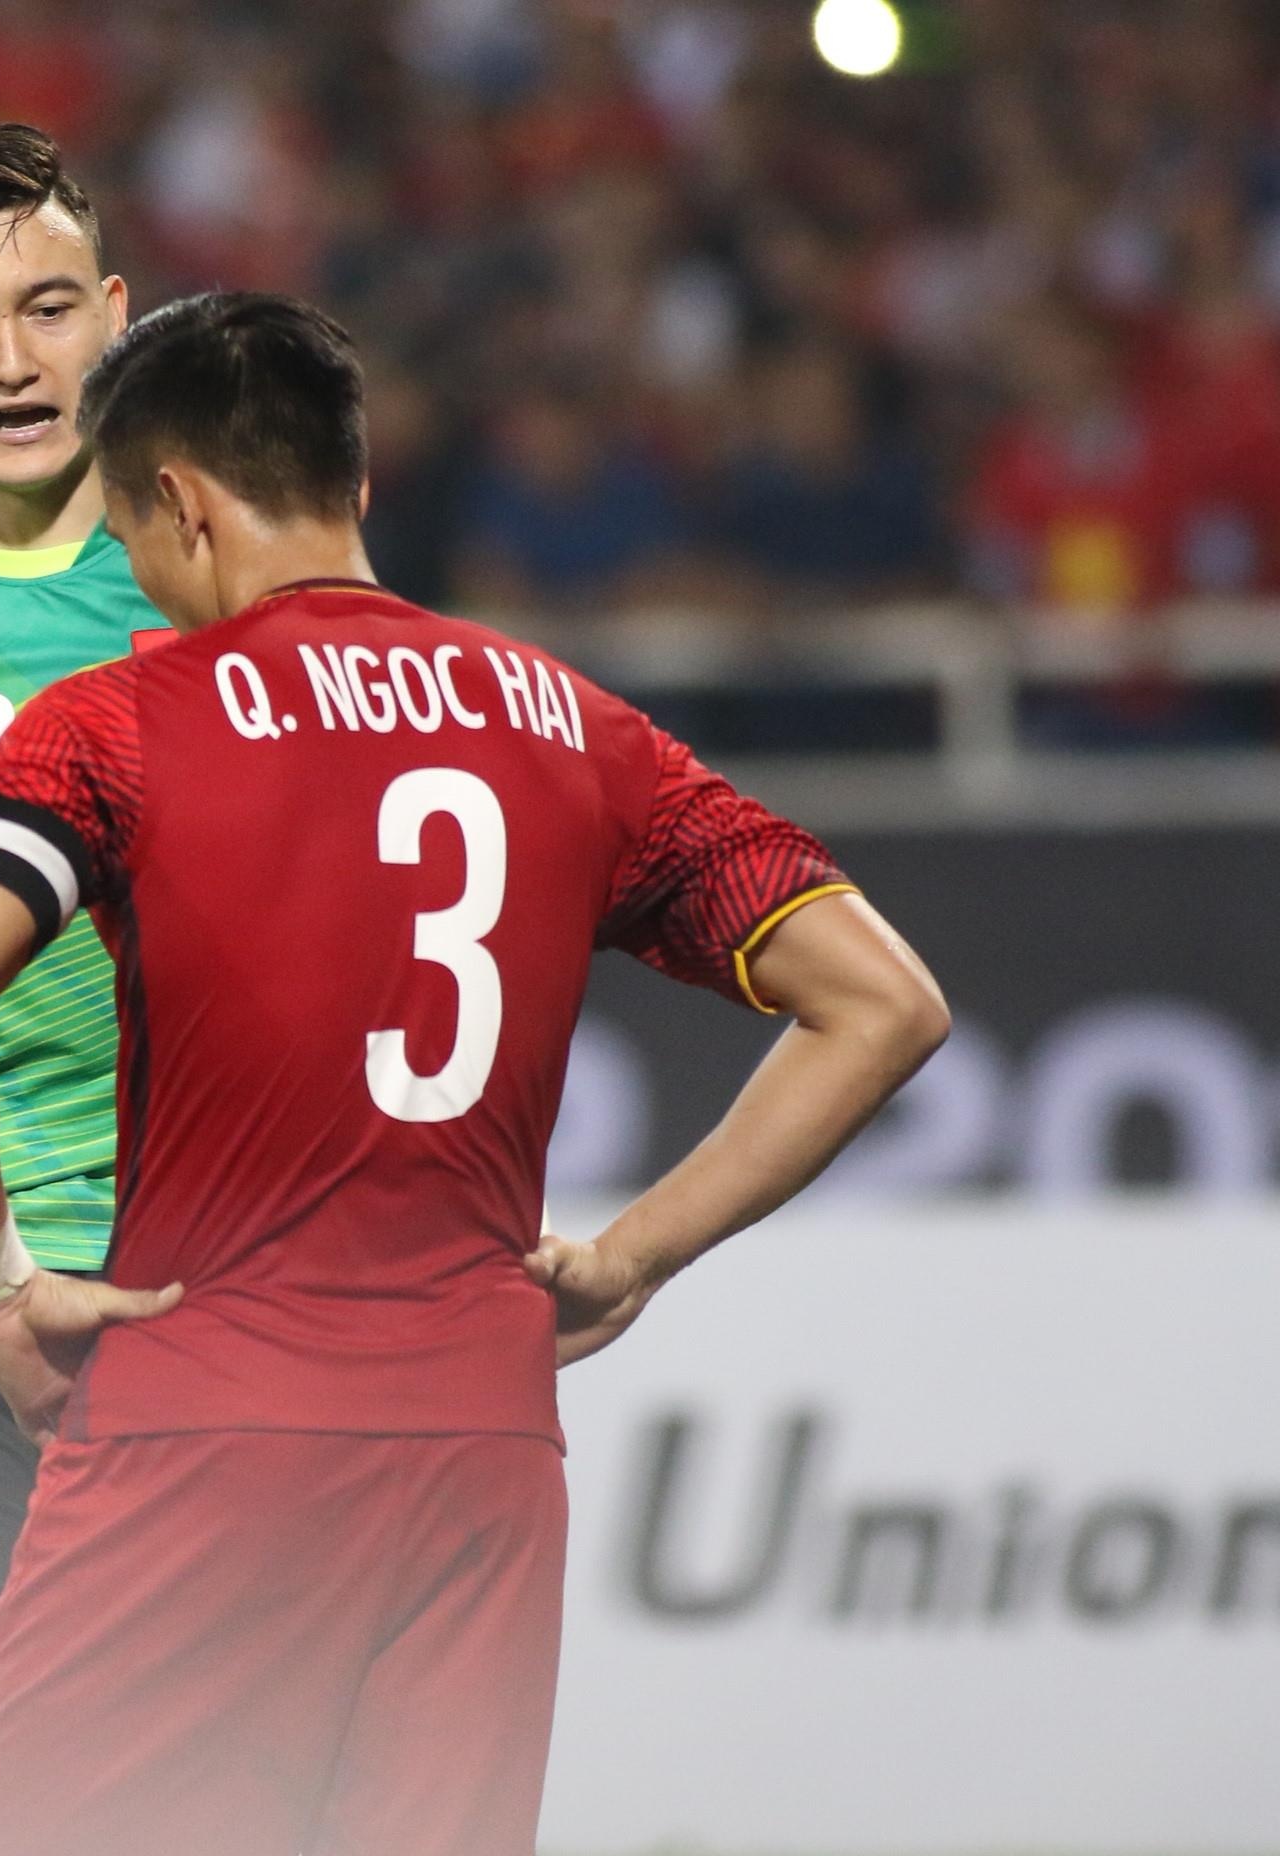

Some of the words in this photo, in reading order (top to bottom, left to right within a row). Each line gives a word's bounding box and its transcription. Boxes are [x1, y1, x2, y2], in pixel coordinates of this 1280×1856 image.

[214, 652, 298, 741] Q.
[297, 643, 486, 734] NGOC
[483, 646, 586, 753] HAI
[365, 767, 508, 1123] 3
